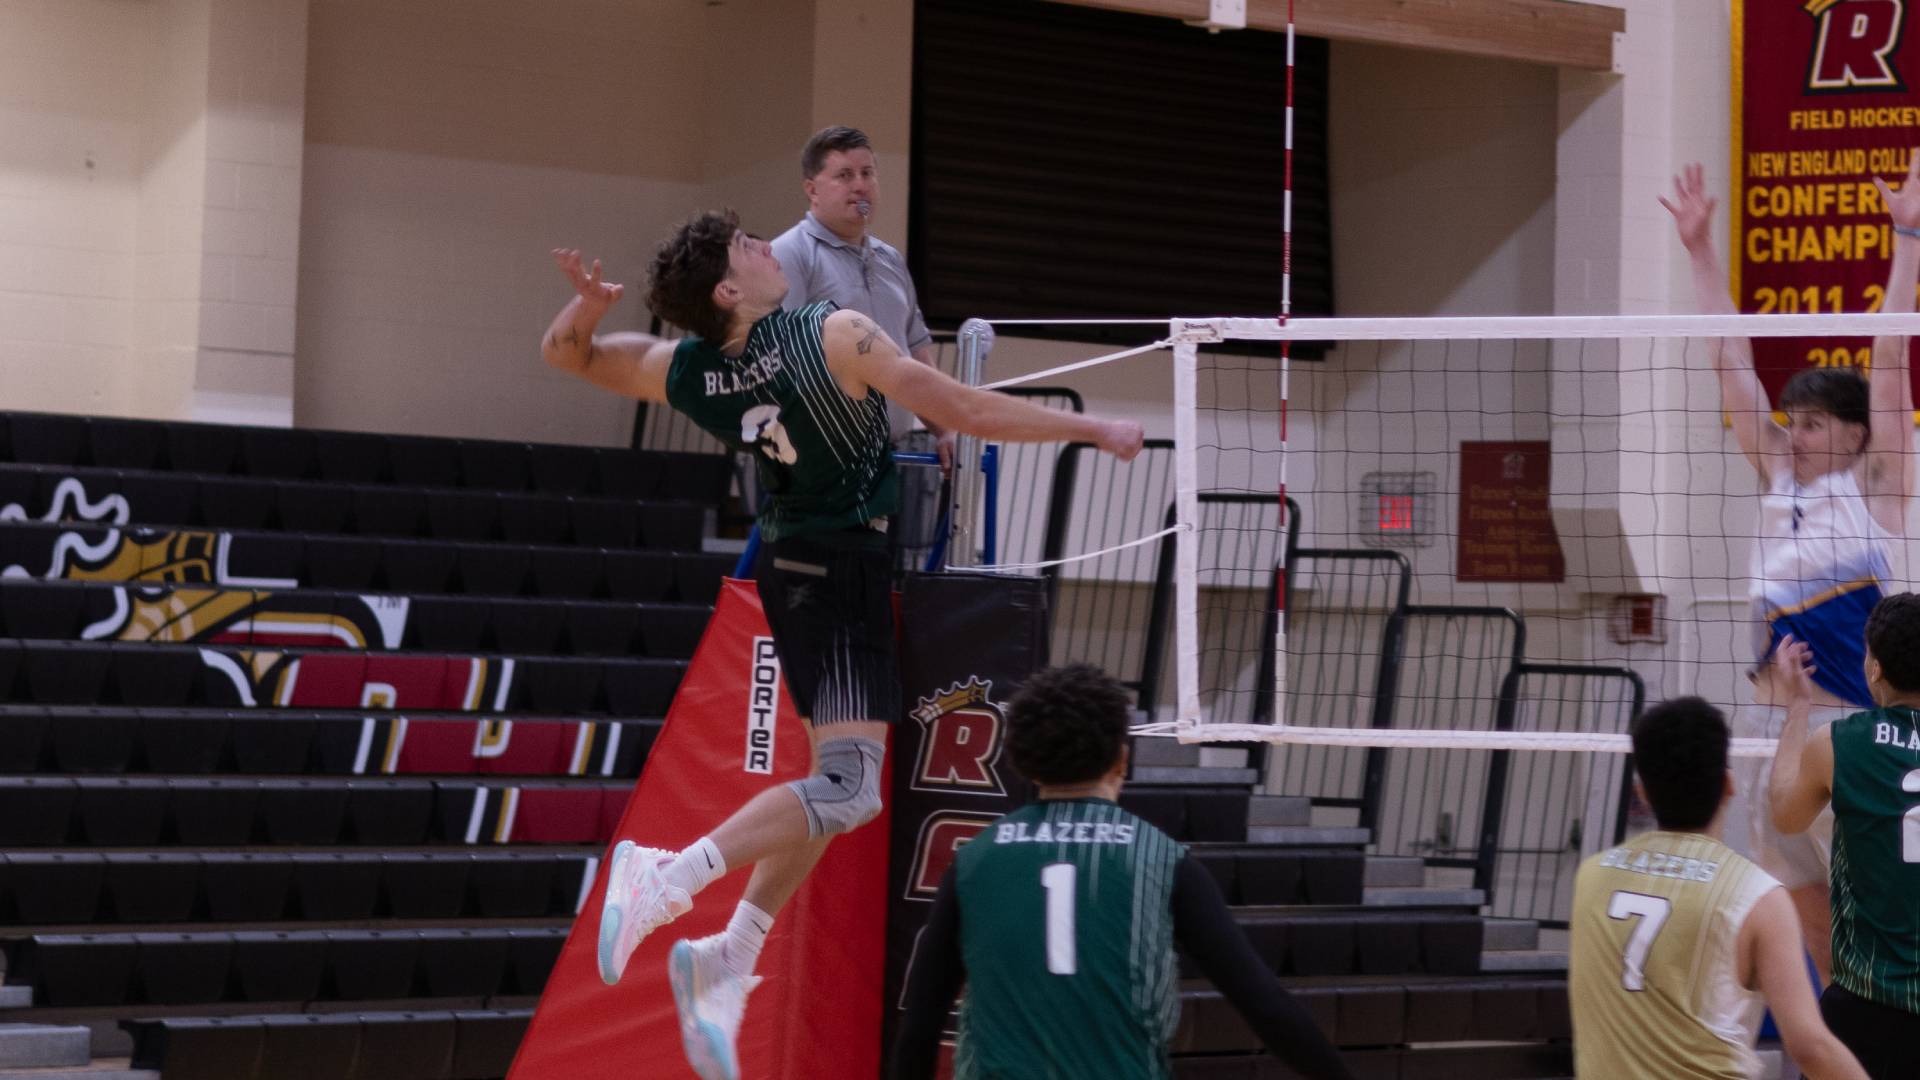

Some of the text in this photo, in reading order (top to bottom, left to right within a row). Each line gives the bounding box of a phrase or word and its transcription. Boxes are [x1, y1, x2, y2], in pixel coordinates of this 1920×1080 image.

[1790, 107, 1920, 130] FIELD HOCKEY
[1749, 148, 1914, 177] NEW ENGLAND COLL
[1746, 224, 1896, 263] CHAMPI
[1754, 285, 1843, 314] 2011
[703, 348, 781, 396] BLAZERS
[918, 707, 1003, 791] R
[995, 822, 1134, 845] BLAZERS
[1600, 848, 1719, 883] BLAZERS
[1040, 862, 1077, 975] 1
[1608, 890, 1671, 992] 7
